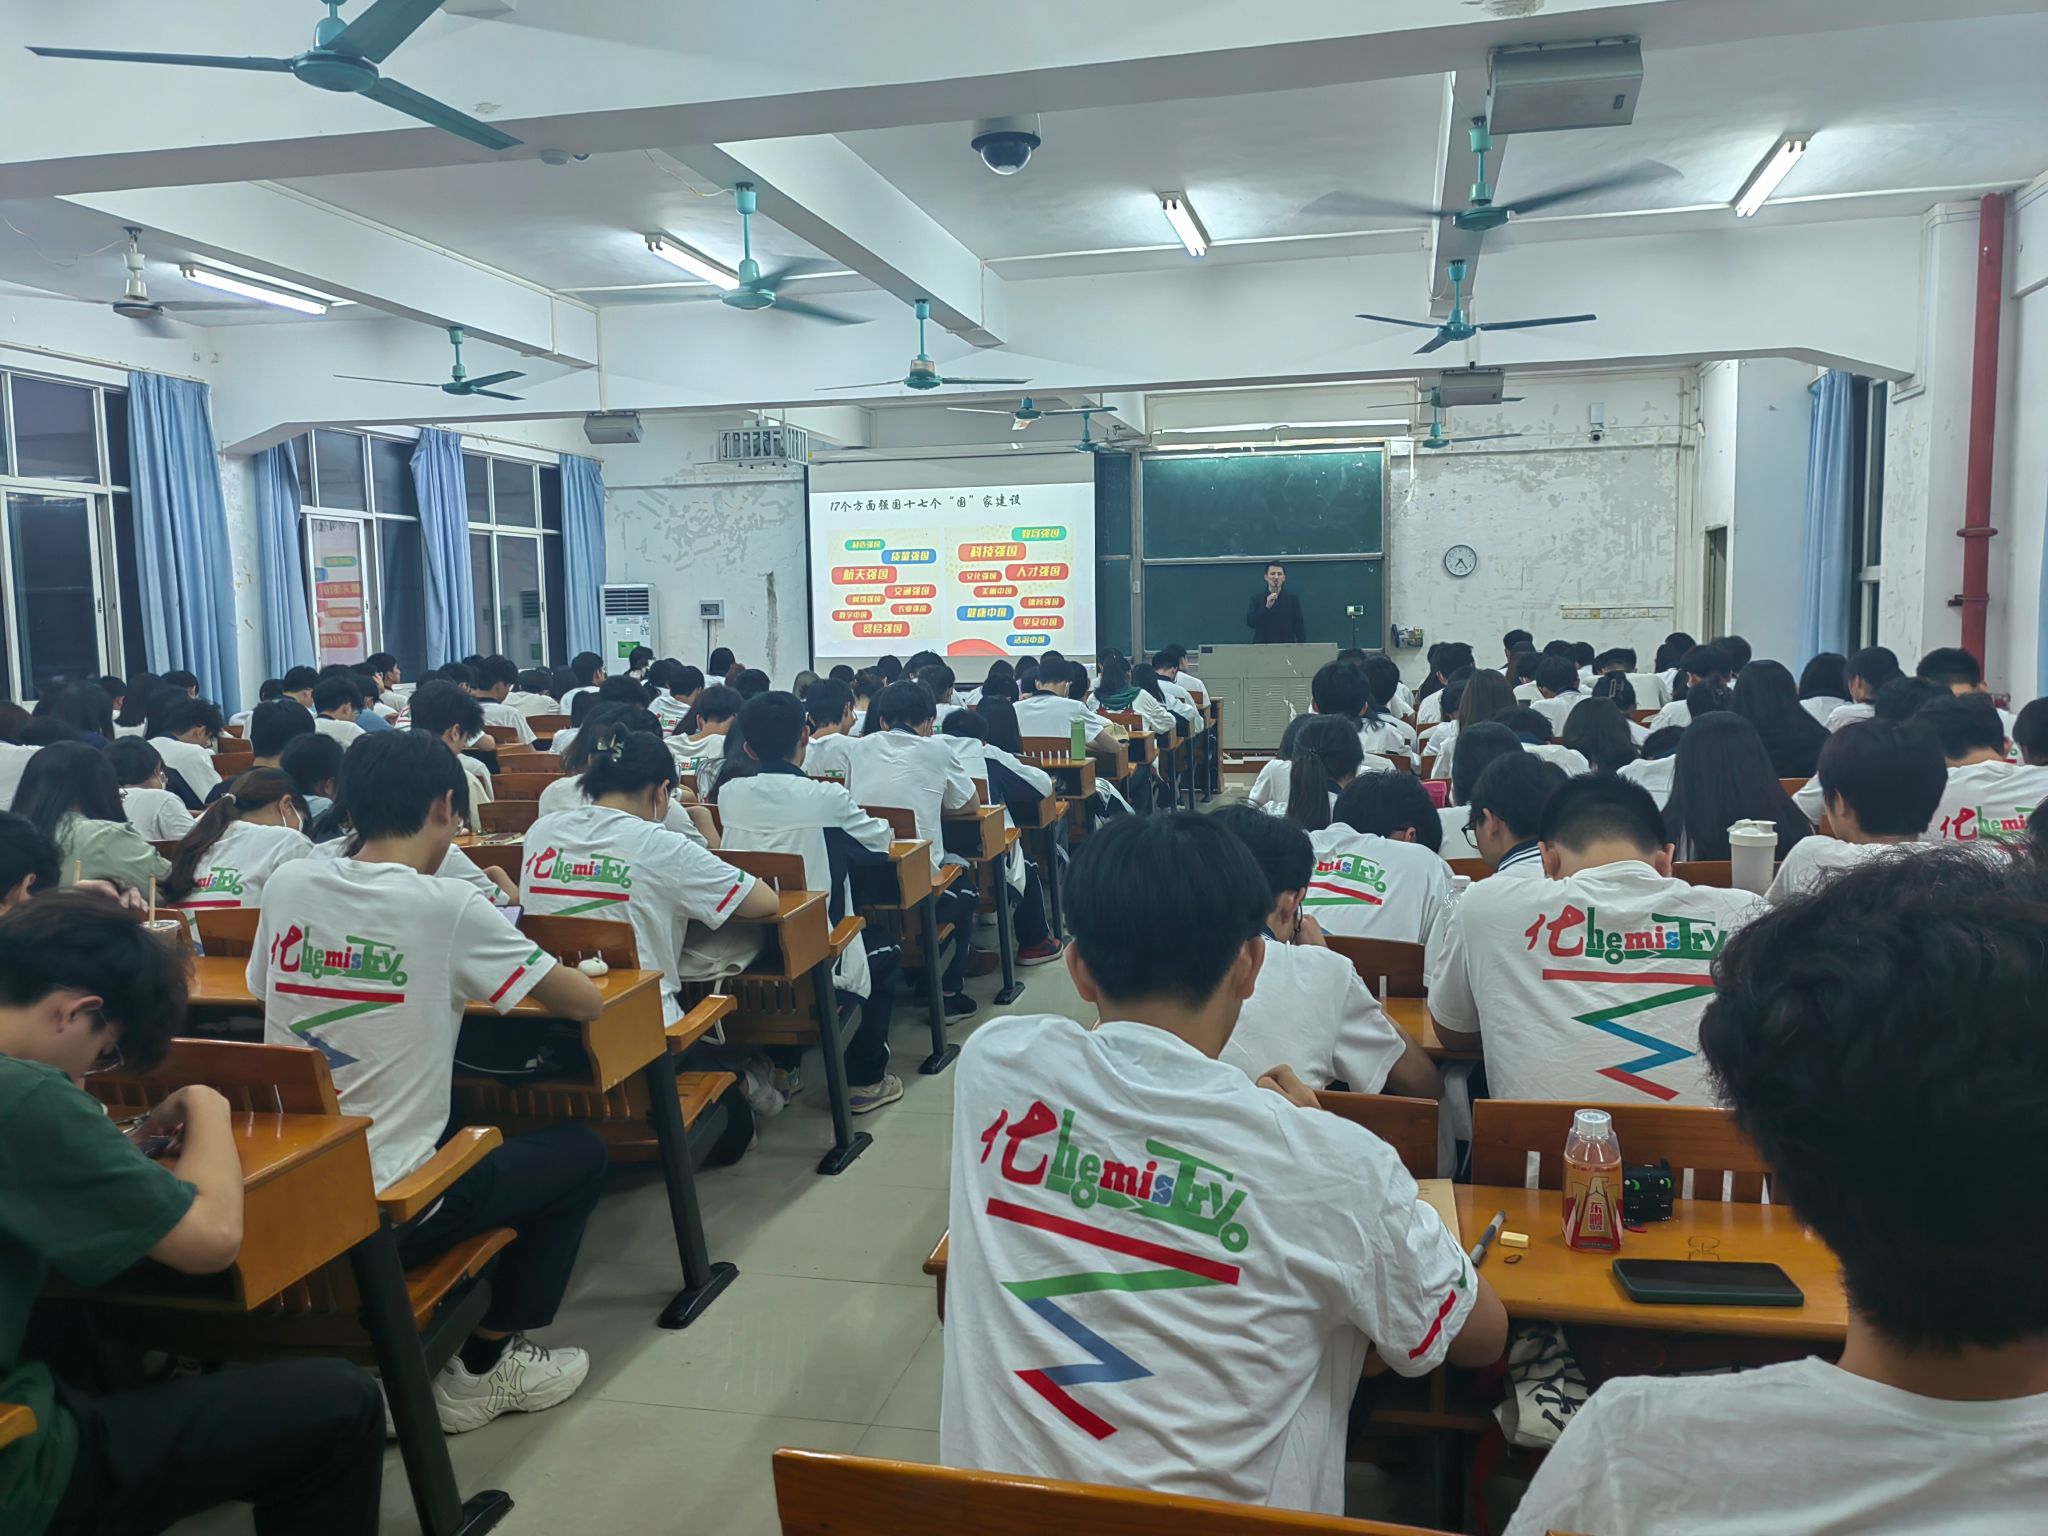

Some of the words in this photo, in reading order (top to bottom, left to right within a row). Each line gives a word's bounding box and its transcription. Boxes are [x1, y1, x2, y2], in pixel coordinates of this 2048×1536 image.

[970, 545, 1018, 558] 科技强国
[843, 568, 889, 581] 航天强国
[966, 572, 997, 581] 文化强国
[1016, 565, 1061, 577] 人才强国
[966, 607, 1007, 618] 健康中国
[1022, 617, 1058, 627] 平安中国
[863, 623, 902, 634] 贸易强国
